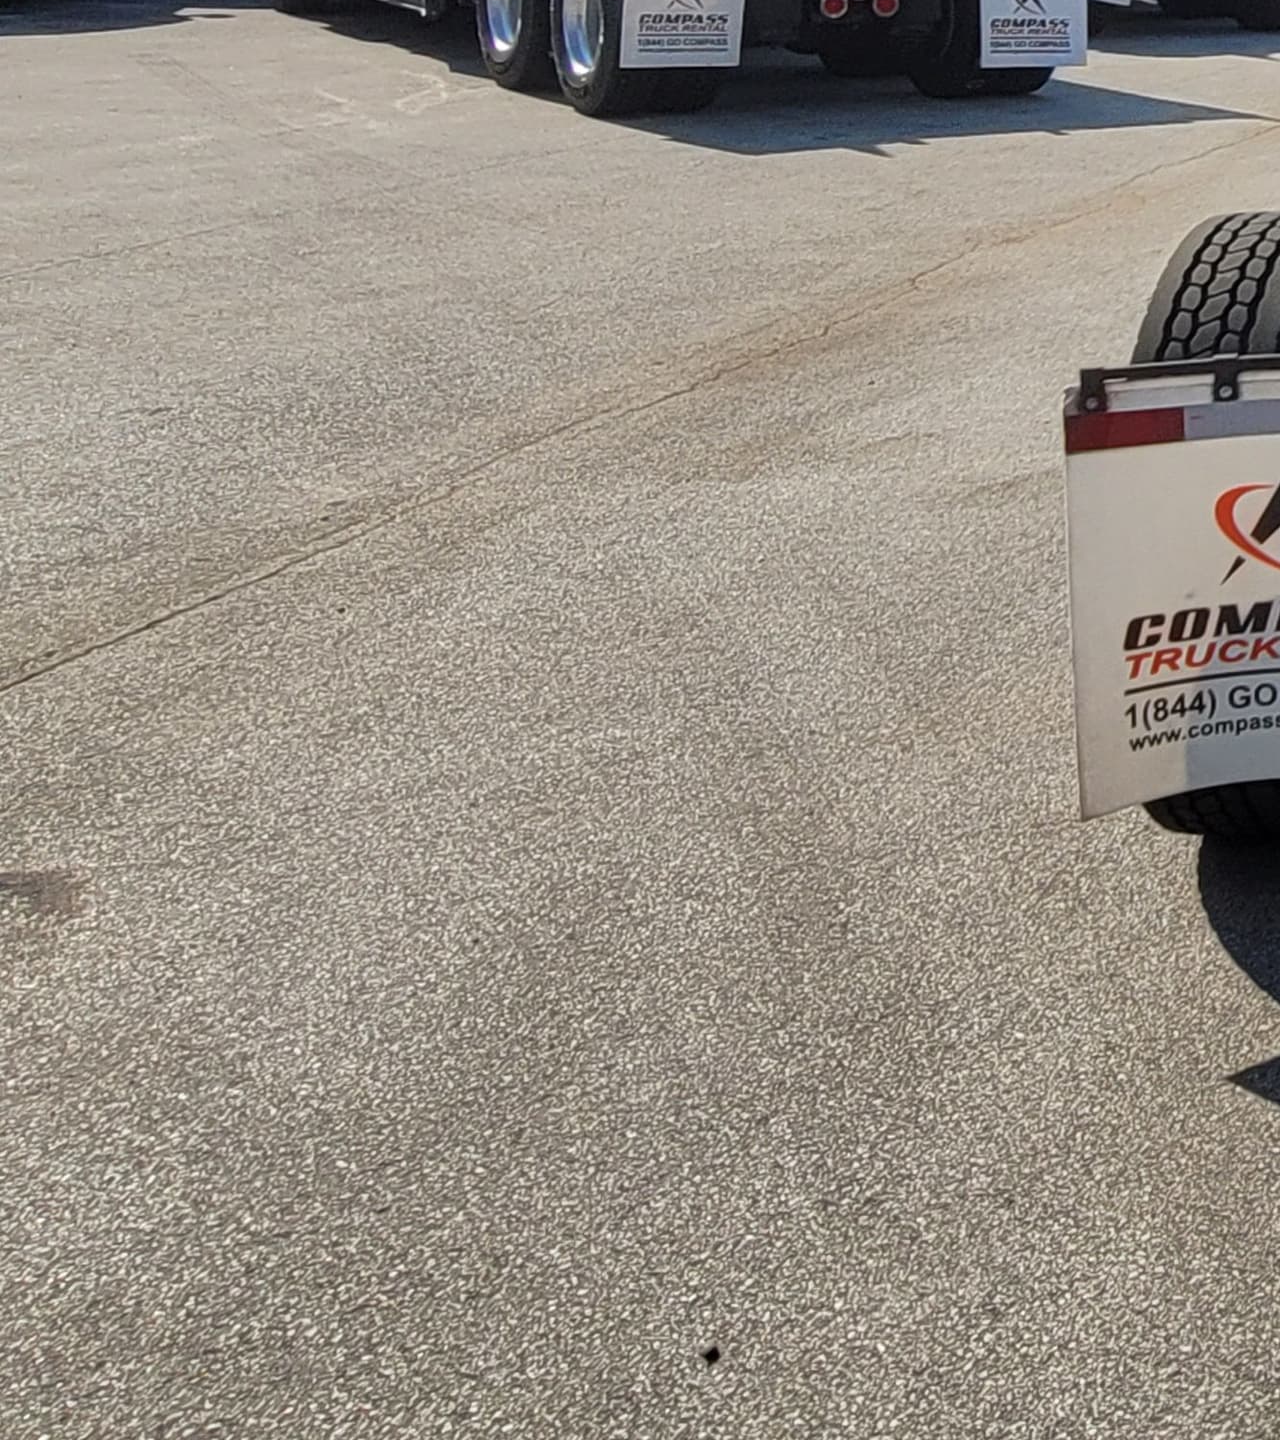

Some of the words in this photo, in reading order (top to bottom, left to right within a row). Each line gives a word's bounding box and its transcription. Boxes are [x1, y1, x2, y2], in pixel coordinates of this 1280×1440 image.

[638, 13, 729, 25] COMPASS
[990, 18, 1070, 28] COMPASS
[1125, 634, 1280, 681] TRUCK
[1124, 688, 1217, 731] 1(844)
[1228, 682, 1278, 710] GO
